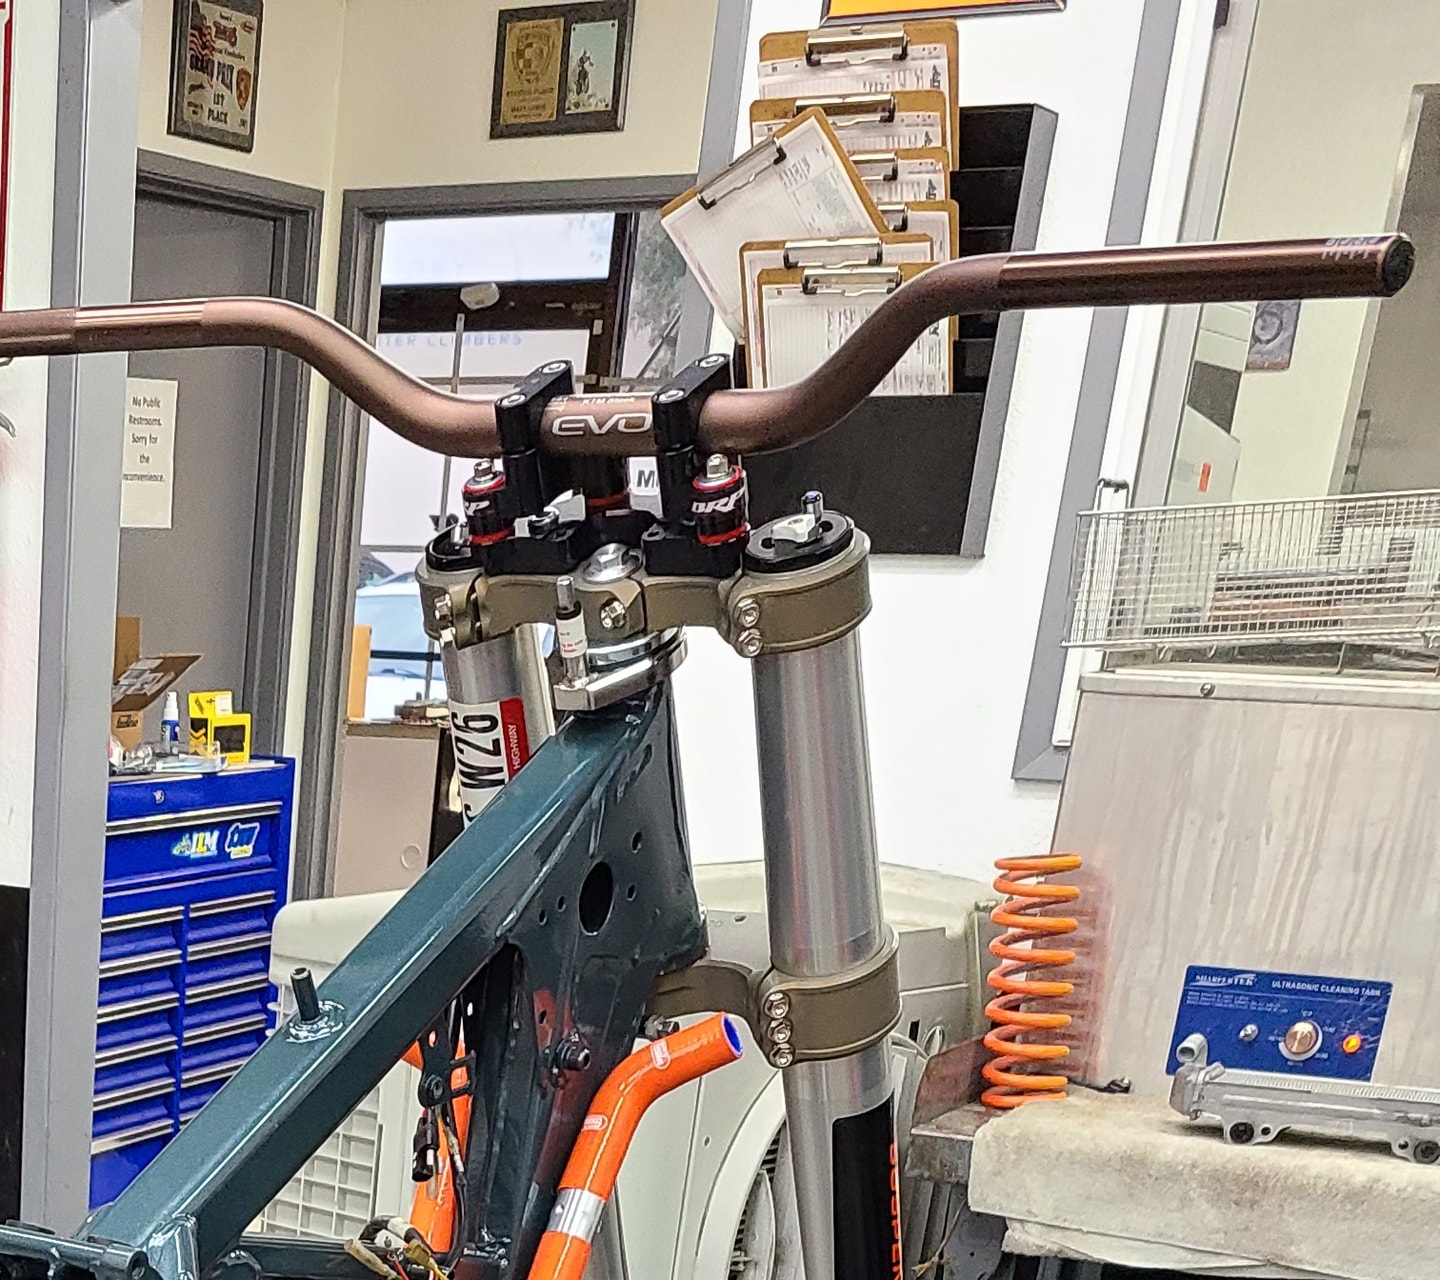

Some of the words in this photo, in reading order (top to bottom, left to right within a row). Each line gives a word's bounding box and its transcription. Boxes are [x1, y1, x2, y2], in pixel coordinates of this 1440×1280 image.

[552, 412, 653, 437] EVO
[139, 453, 150, 464] the
[123, 473, 166, 483] nconvenience.
[507, 723, 522, 770] HIGHWAY
[1271, 980, 1320, 993] ULTRASONIC
[1320, 984, 1360, 996] CLEANING
